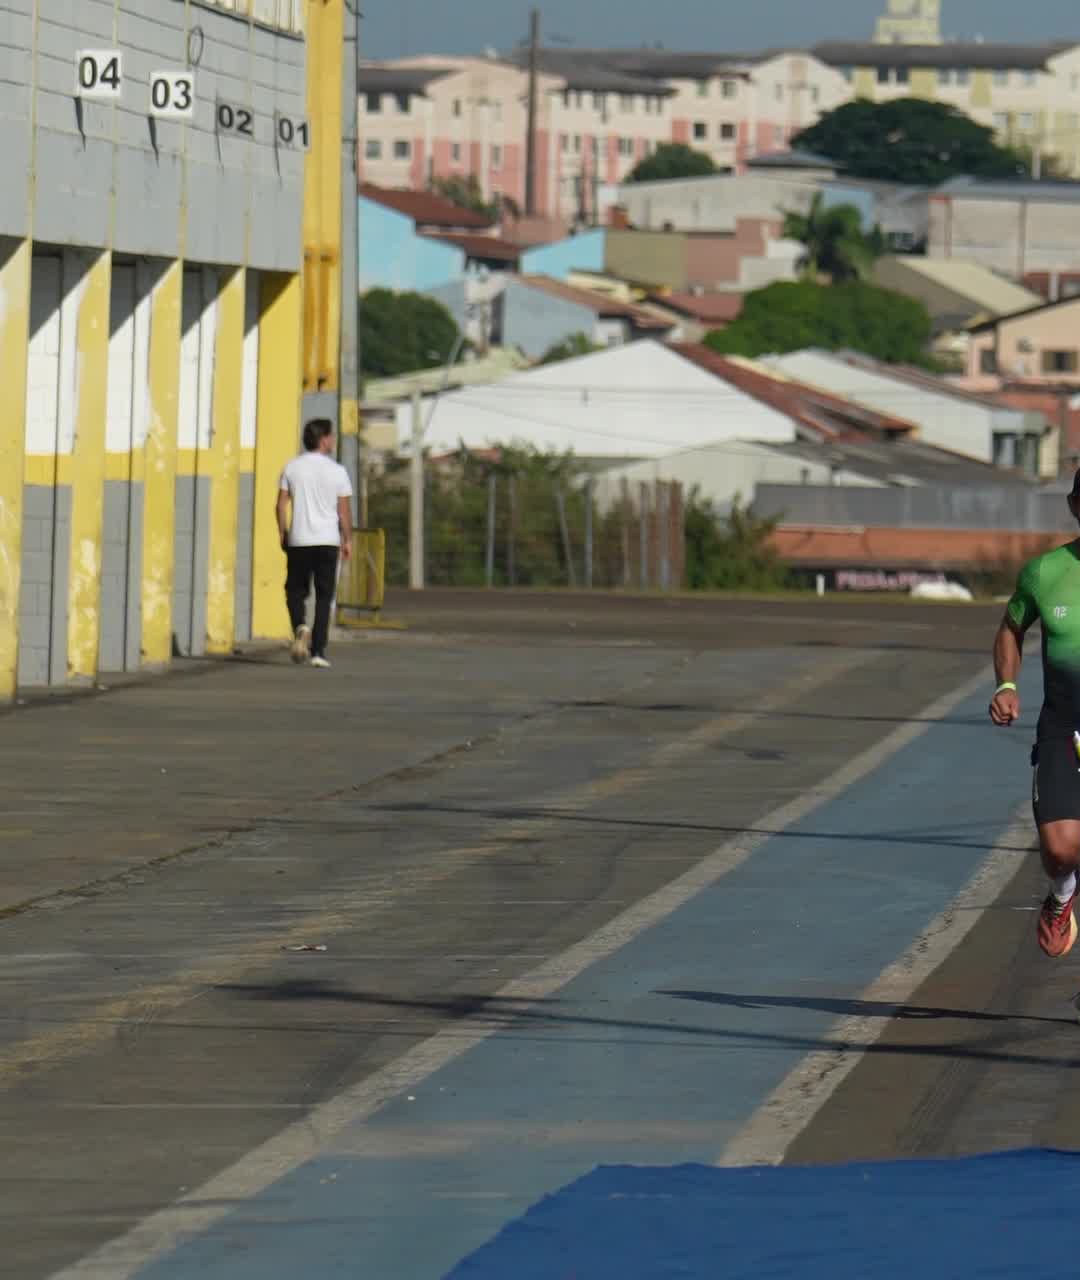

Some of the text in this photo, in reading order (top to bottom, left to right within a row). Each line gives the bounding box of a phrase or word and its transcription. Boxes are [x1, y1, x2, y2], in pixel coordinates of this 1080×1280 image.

[78, 56, 121, 90] 04
[151, 78, 192, 110] 03
[218, 105, 253, 135] 02
[278, 118, 309, 147] 01
